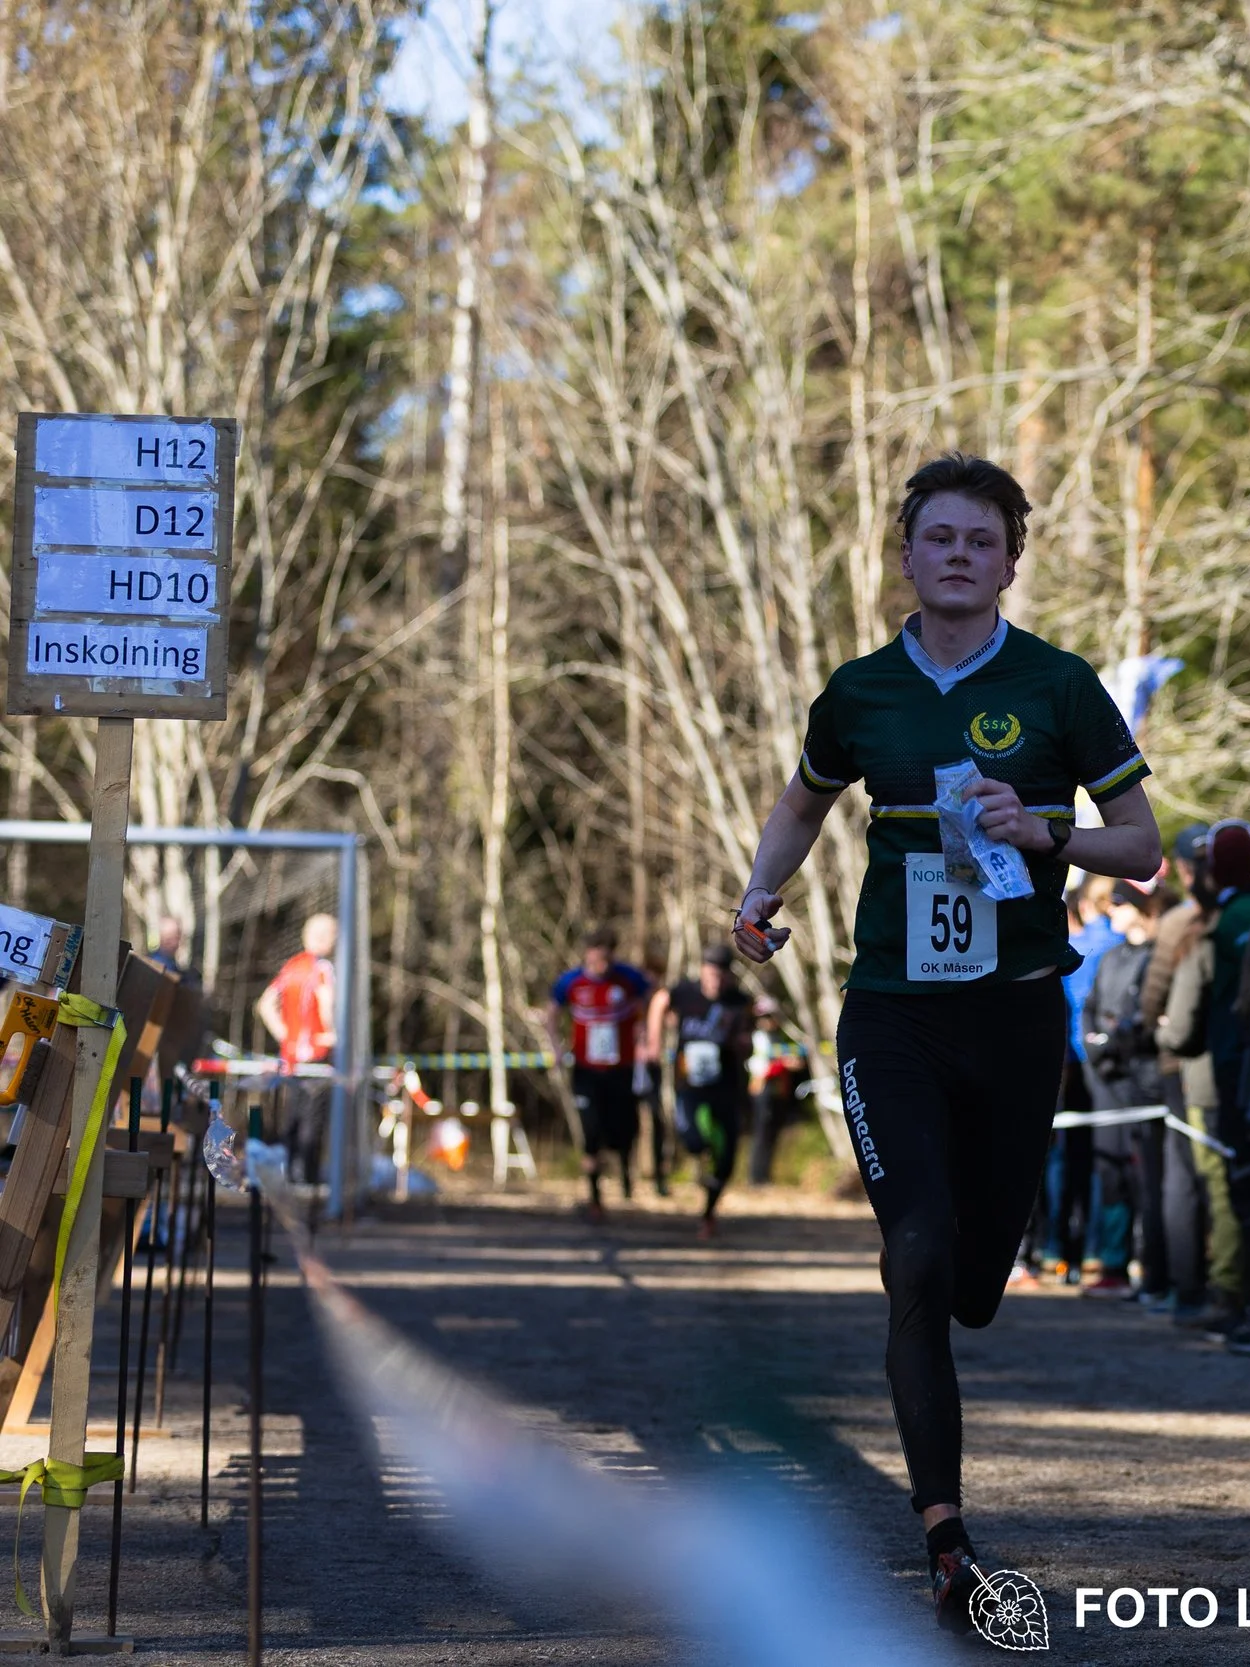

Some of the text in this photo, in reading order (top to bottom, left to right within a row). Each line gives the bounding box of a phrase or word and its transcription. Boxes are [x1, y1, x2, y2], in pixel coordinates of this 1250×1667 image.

[137, 437, 207, 469] H12
[136, 505, 205, 537] D12
[109, 569, 209, 604] HD10
[34, 635, 201, 675] Inskolning
[954, 637, 996, 673] noname
[983, 719, 1009, 731] SSK
[963, 731, 1026, 759] ORIENTERING HUDDINGE
[930, 894, 973, 954] 59
[920, 961, 984, 974] OK Måsen
[843, 1057, 885, 1181] bagheera
